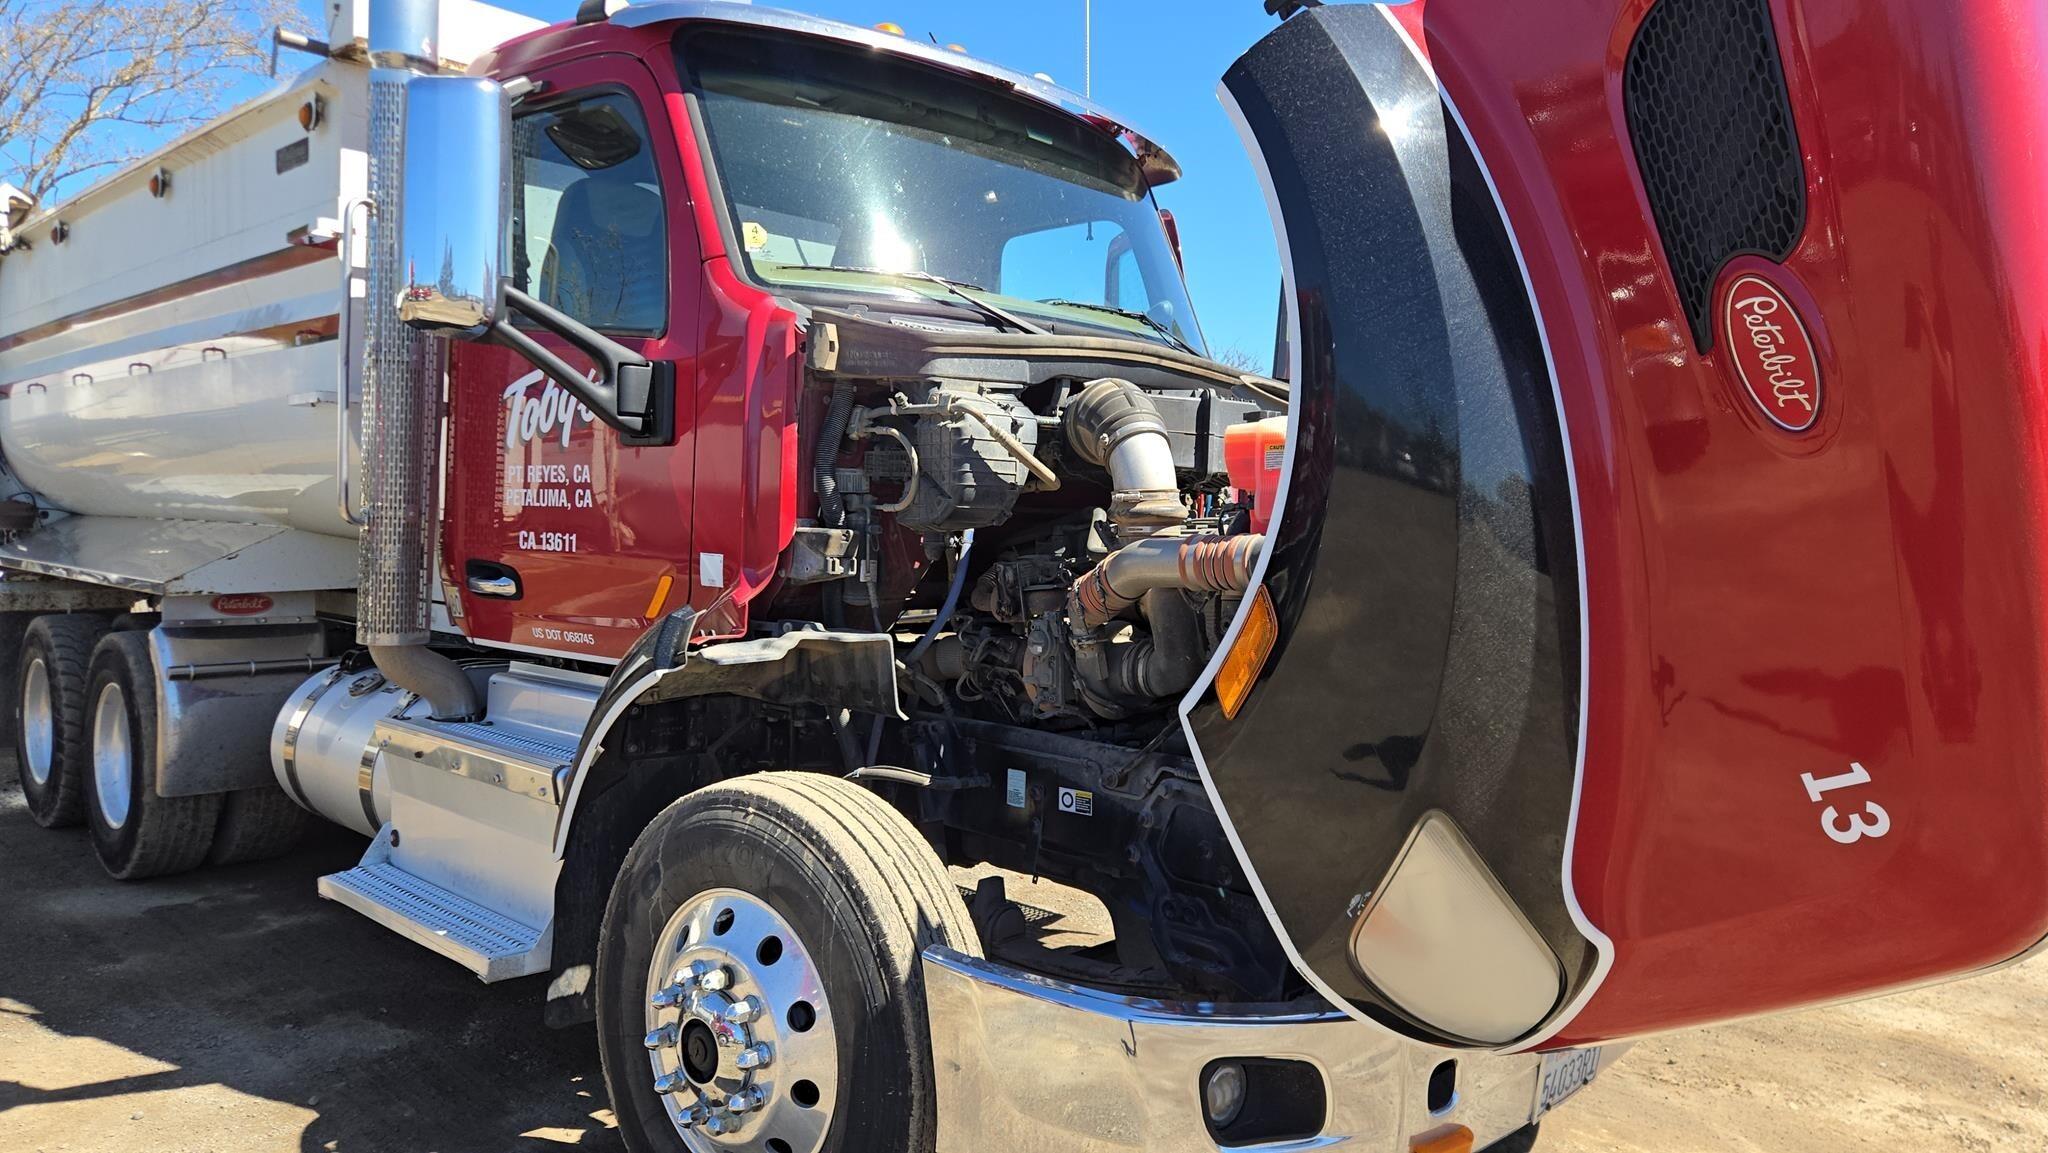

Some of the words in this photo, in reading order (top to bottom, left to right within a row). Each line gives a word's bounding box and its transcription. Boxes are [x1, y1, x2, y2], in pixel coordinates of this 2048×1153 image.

[1734, 296, 1812, 411] Peterbilt
[527, 464, 570, 486] REYES,
[573, 464, 591, 484] CA
[506, 488, 572, 510] PETALUMA,
[575, 488, 593, 508] CA
[519, 530, 537, 550] CA
[540, 532, 577, 553] 13611
[217, 597, 267, 610] Peterbilt
[532, 627, 544, 639] US
[545, 629, 562, 641] DOT
[563, 630, 595, 645] 068745
[1800, 762, 1891, 844] 13
